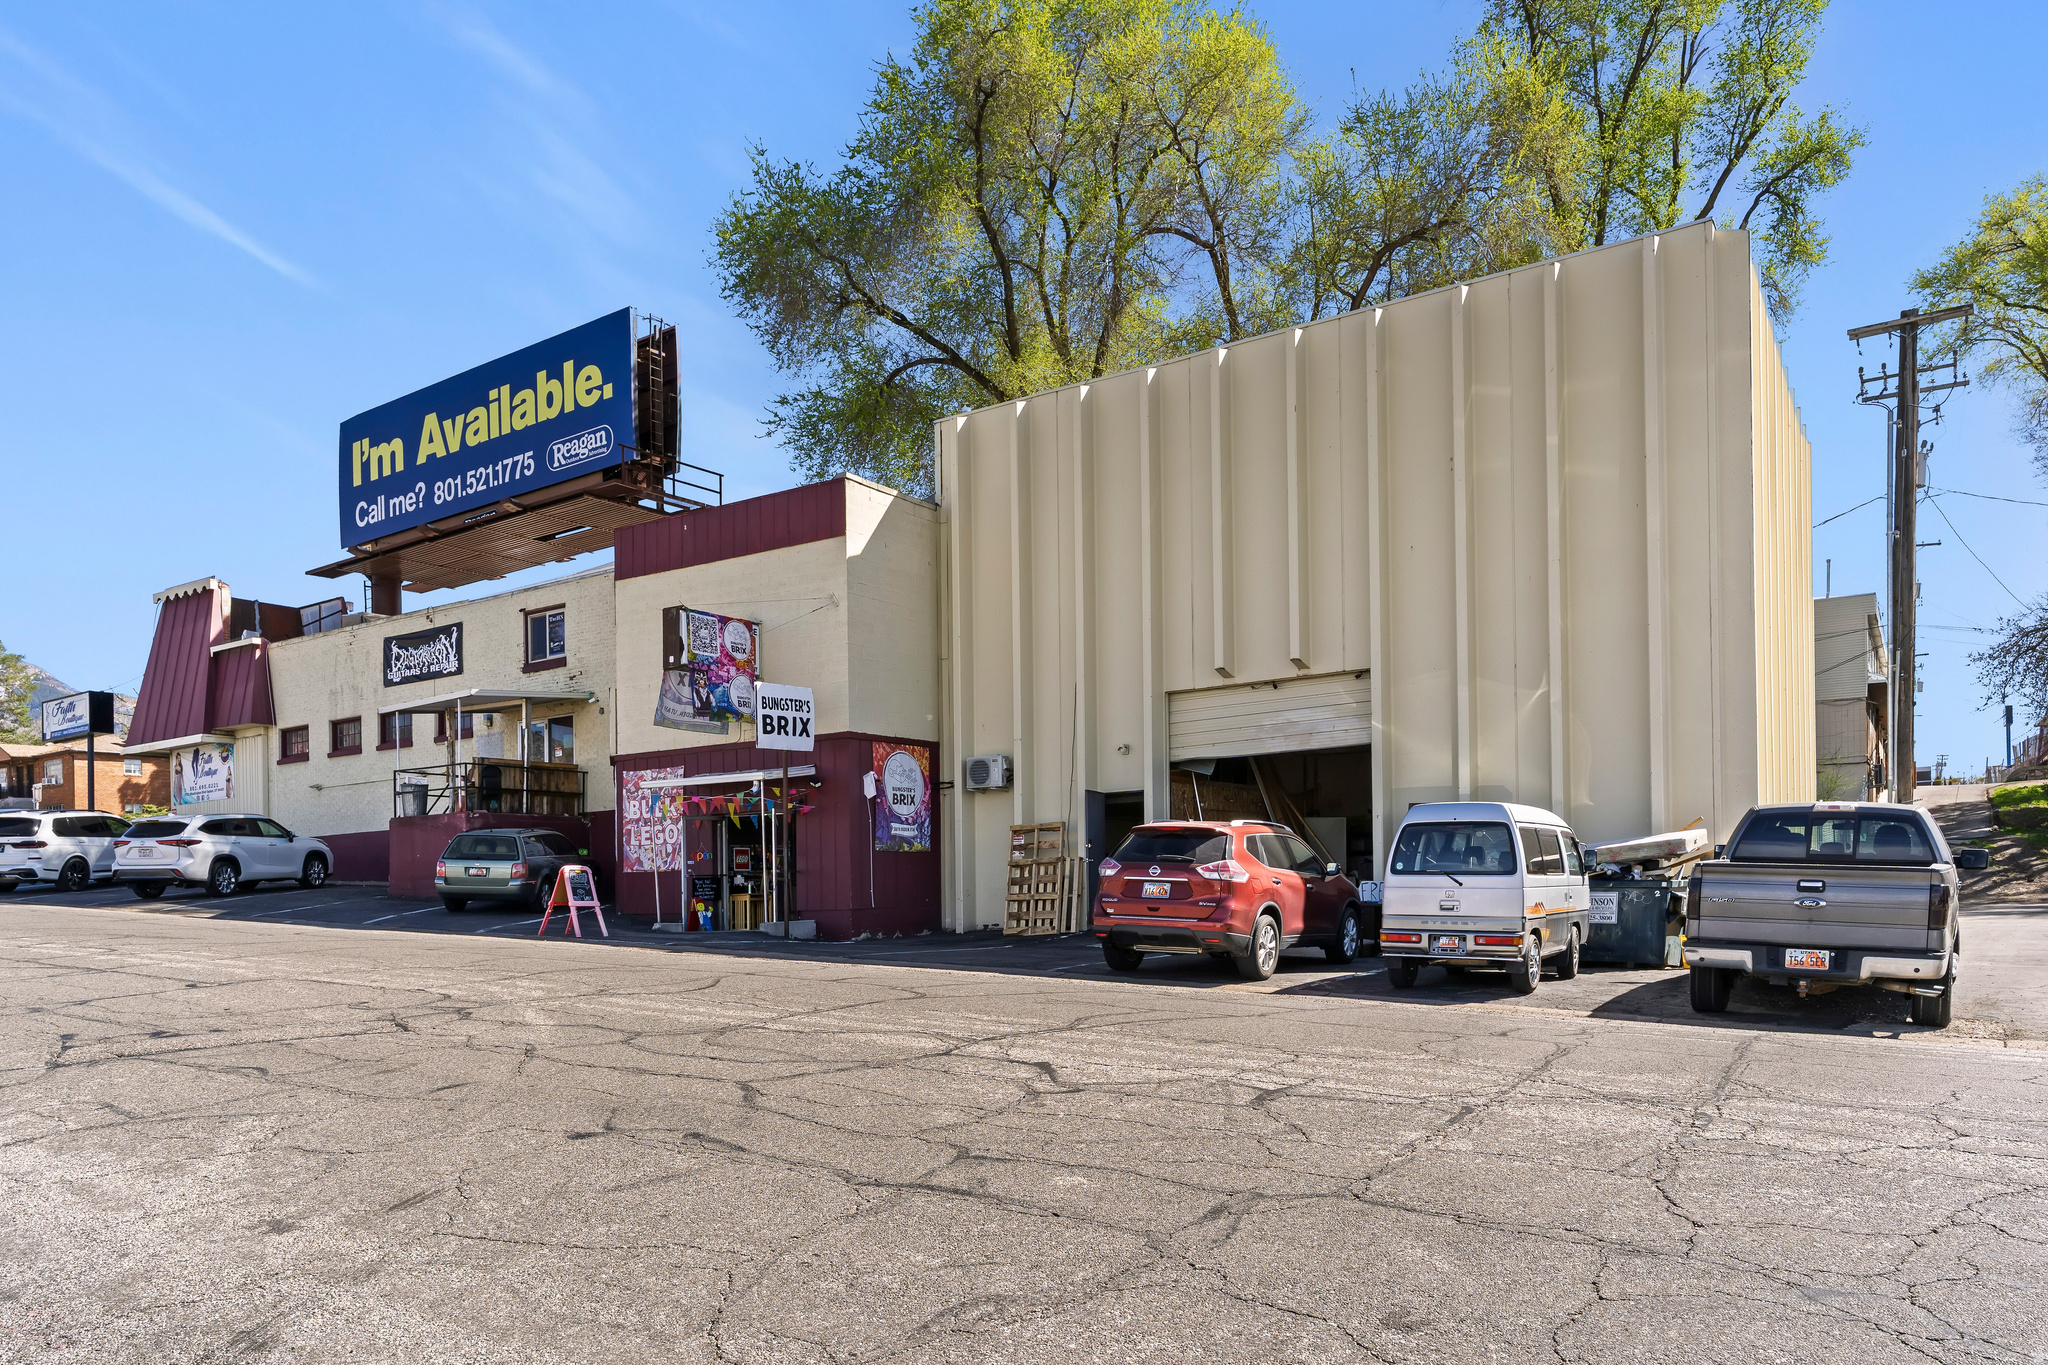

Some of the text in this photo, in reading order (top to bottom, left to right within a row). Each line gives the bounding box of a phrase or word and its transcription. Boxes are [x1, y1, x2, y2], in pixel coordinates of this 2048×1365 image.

[352, 359, 613, 488] I'm Available.
[552, 430, 607, 467] Reagan
[355, 451, 535, 528] Call me? 801.521.1775
[731, 645, 747, 655] BRIX
[387, 668, 421, 680] GUITARS
[430, 660, 458, 673] REPAIR
[761, 696, 811, 713] BUNGSTER'S
[762, 714, 811, 738] BRIX
[892, 793, 916, 806] BRIX
[630, 824, 678, 846] LEGO
[736, 855, 748, 863] LEGO
[1590, 897, 1615, 906] INSON
[1788, 955, 1827, 967] T56 5ER
